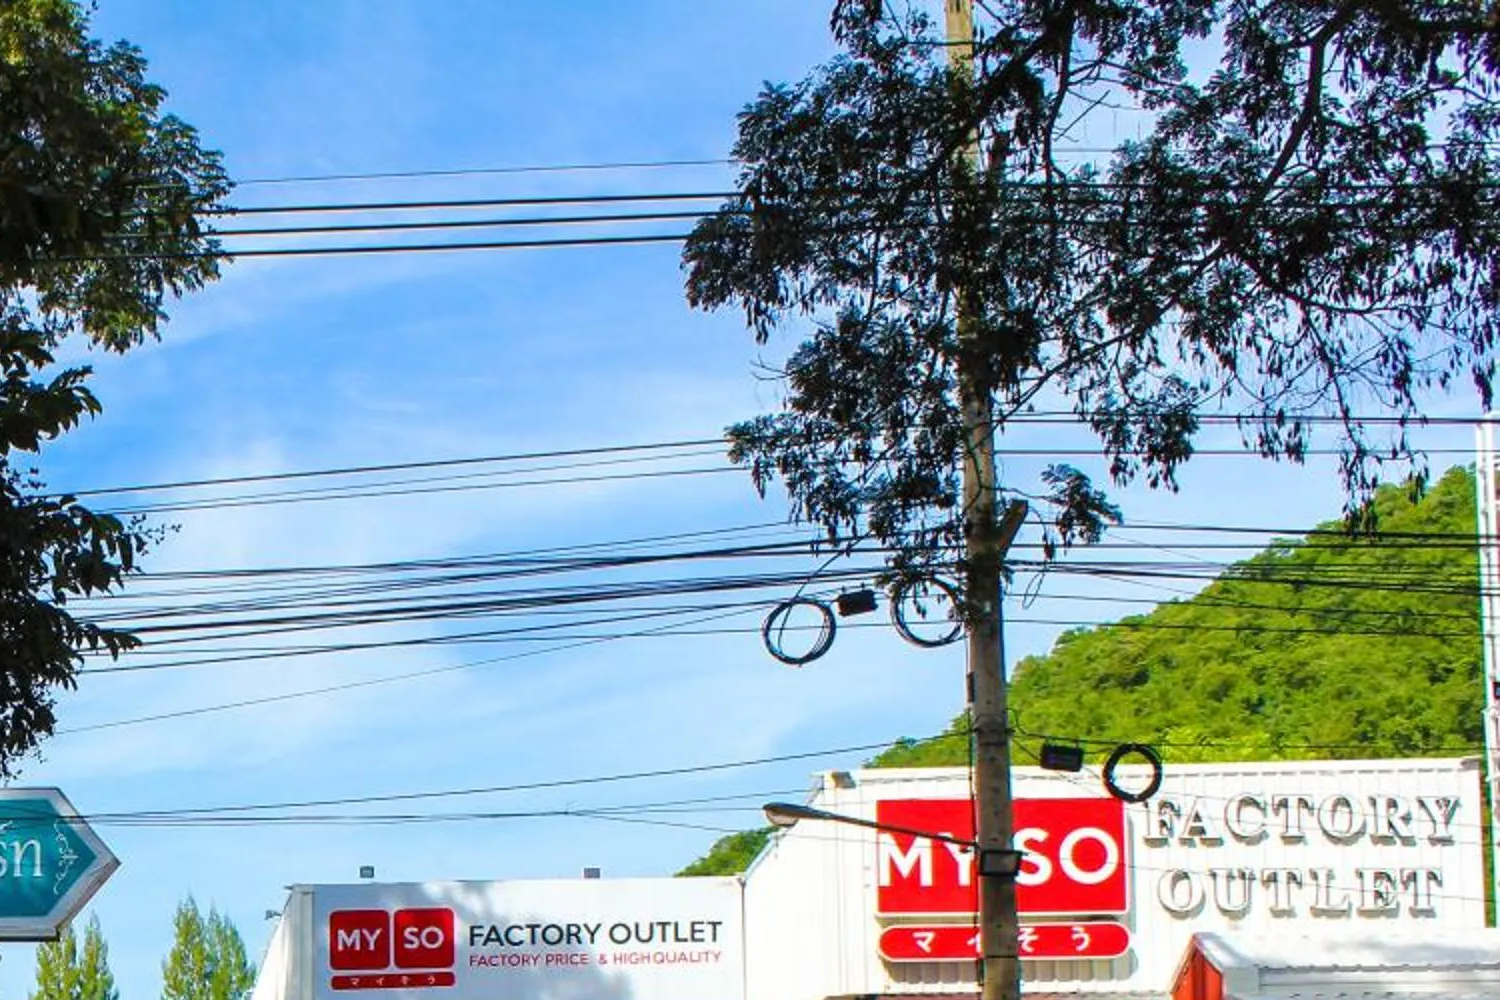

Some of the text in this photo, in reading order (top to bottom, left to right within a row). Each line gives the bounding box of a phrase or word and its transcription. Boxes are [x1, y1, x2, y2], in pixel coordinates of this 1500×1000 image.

[1142, 793, 1461, 845] FACTORY
[877, 827, 1120, 888] MY SO
[1156, 867, 1444, 917] OUTLET
[336, 926, 445, 951] MY SO
[468, 921, 723, 947] FACTORY OUTLET
[468, 953, 540, 968] FACTORY
[545, 953, 589, 966] PRICE
[598, 953, 608, 965] &
